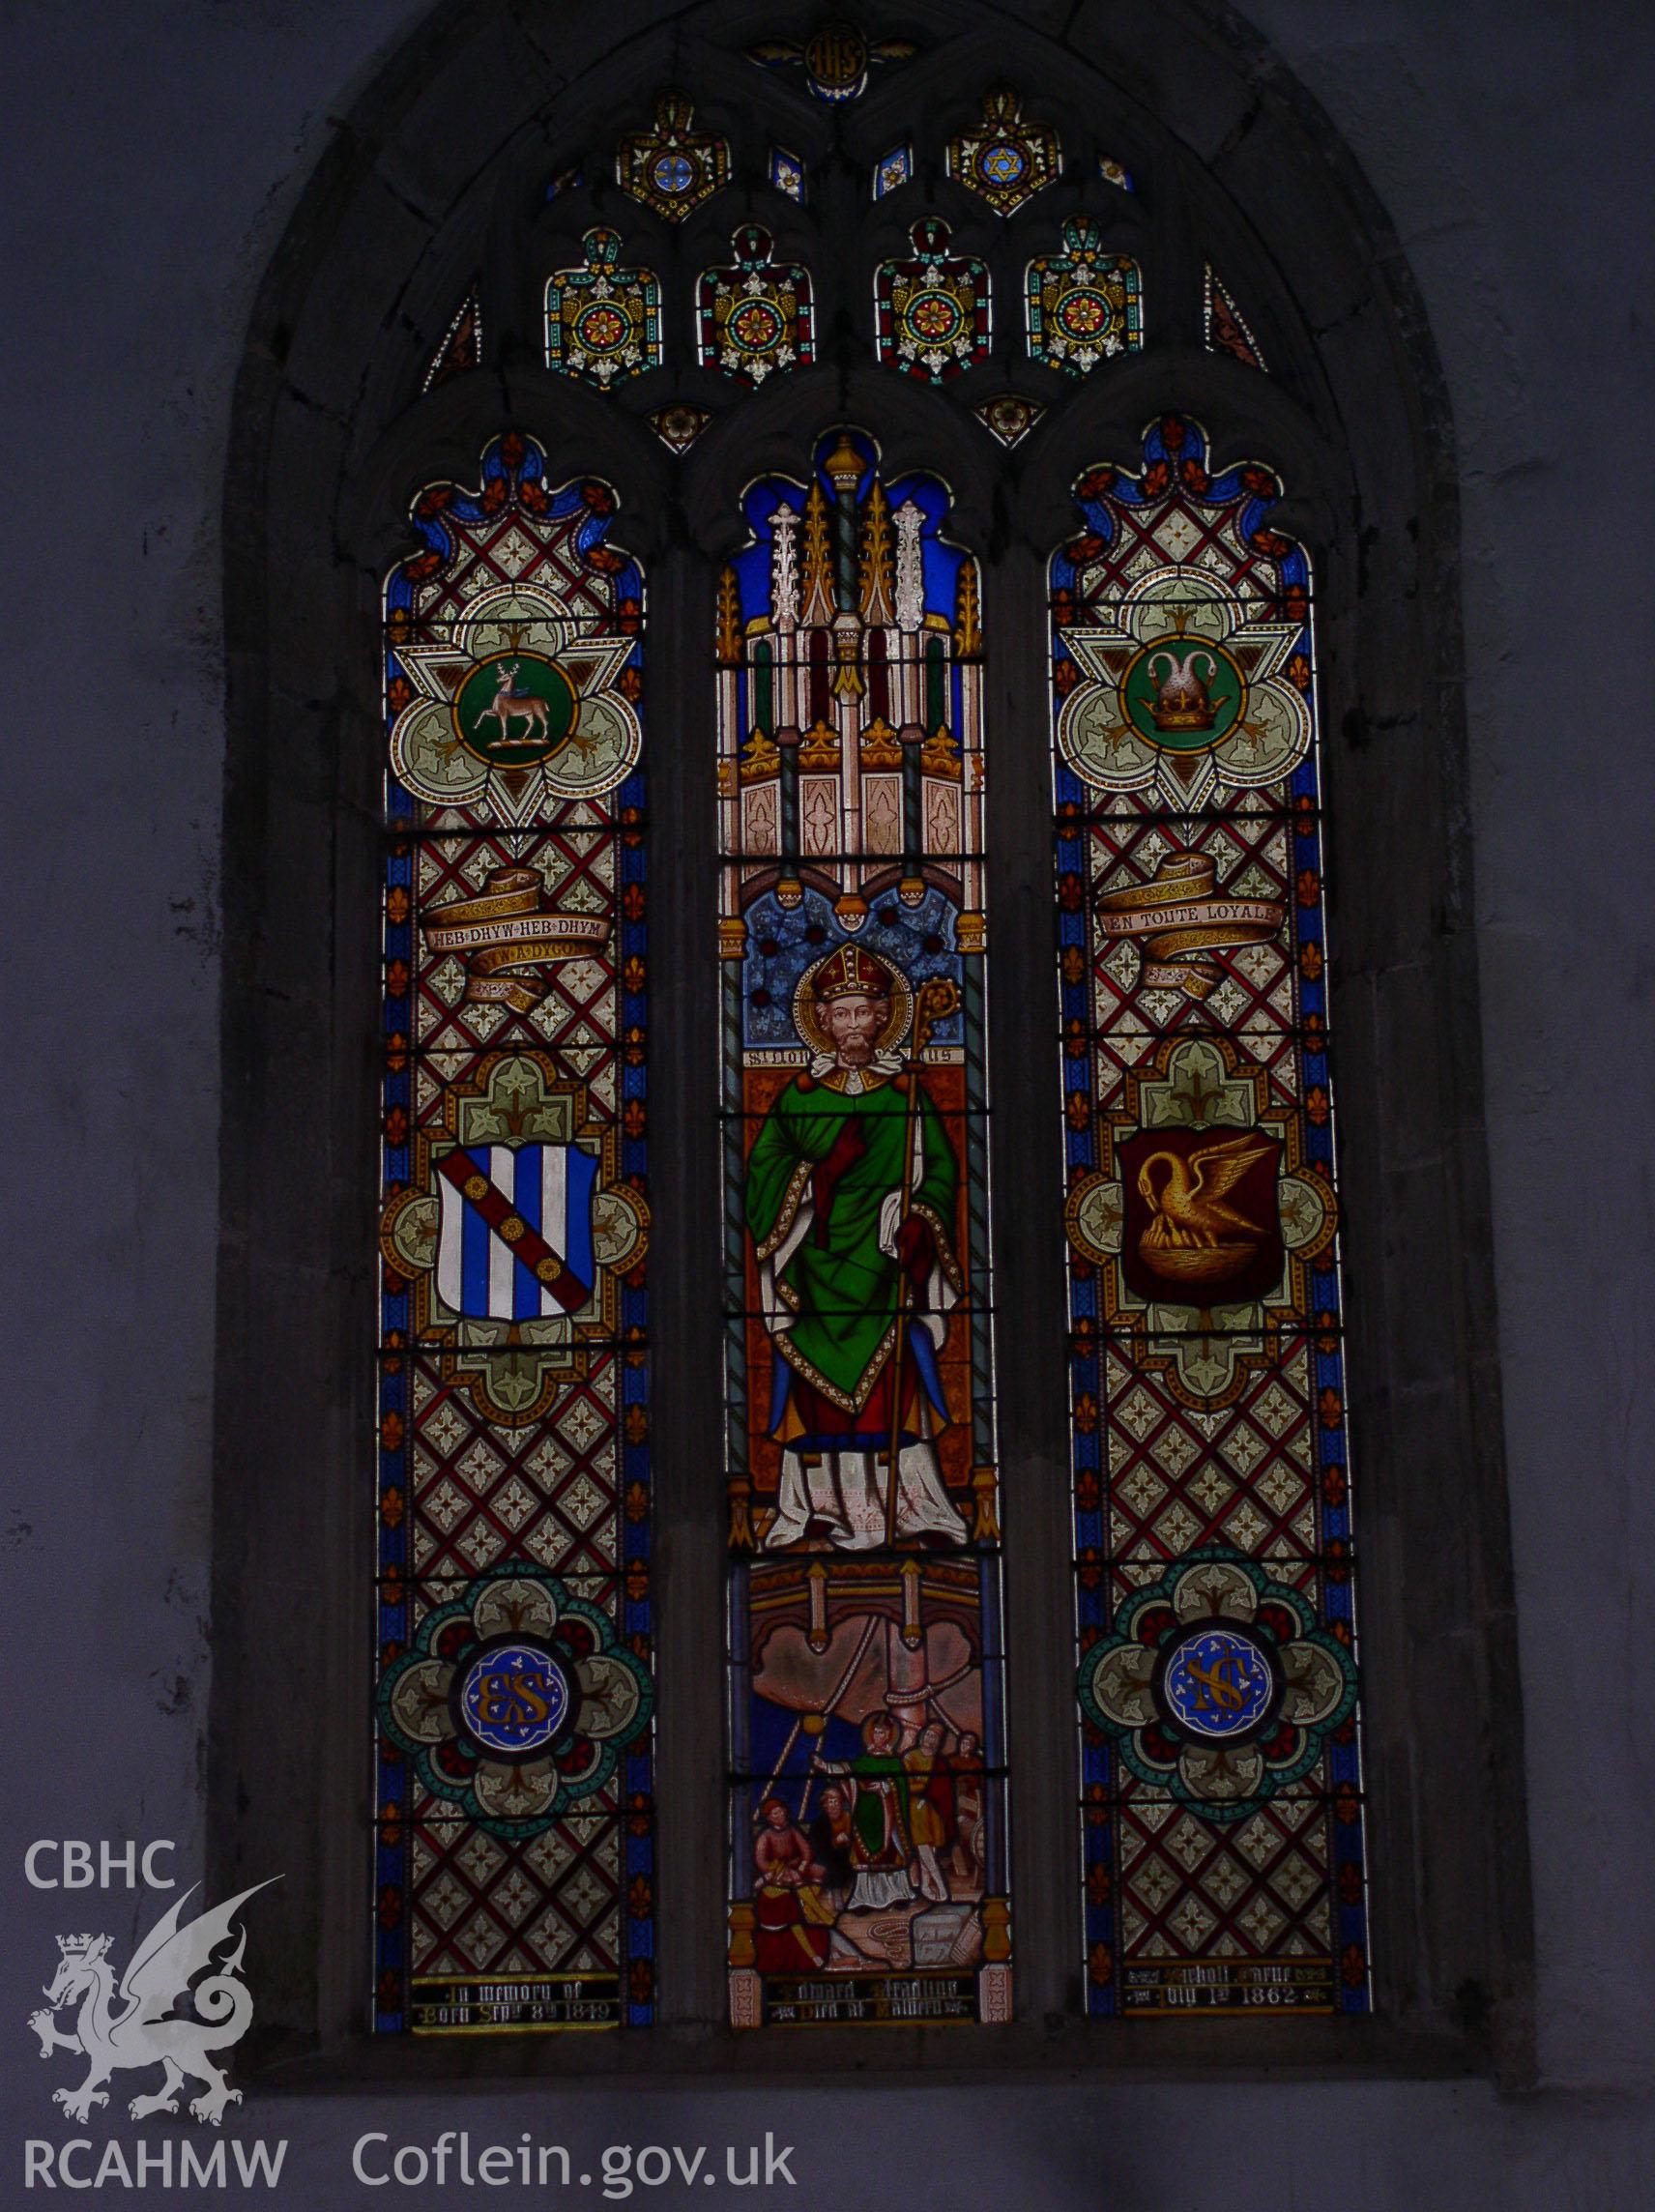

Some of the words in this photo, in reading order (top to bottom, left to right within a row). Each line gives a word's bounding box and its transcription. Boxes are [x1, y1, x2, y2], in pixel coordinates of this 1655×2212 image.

[1110, 916, 1132, 930] EN
[1141, 906, 1199, 927] TOUTE
[434, 932, 465, 946] HEB
[471, 924, 514, 944] DHYW
[519, 921, 552, 937] HEB
[559, 919, 601, 936] DHYM
[479, 1984, 551, 2002] memory
[564, 1981, 582, 2000] of
[1241, 1986, 1297, 2004] 1862
[421, 2006, 469, 2023] Born
[566, 2002, 611, 2021] 1849
